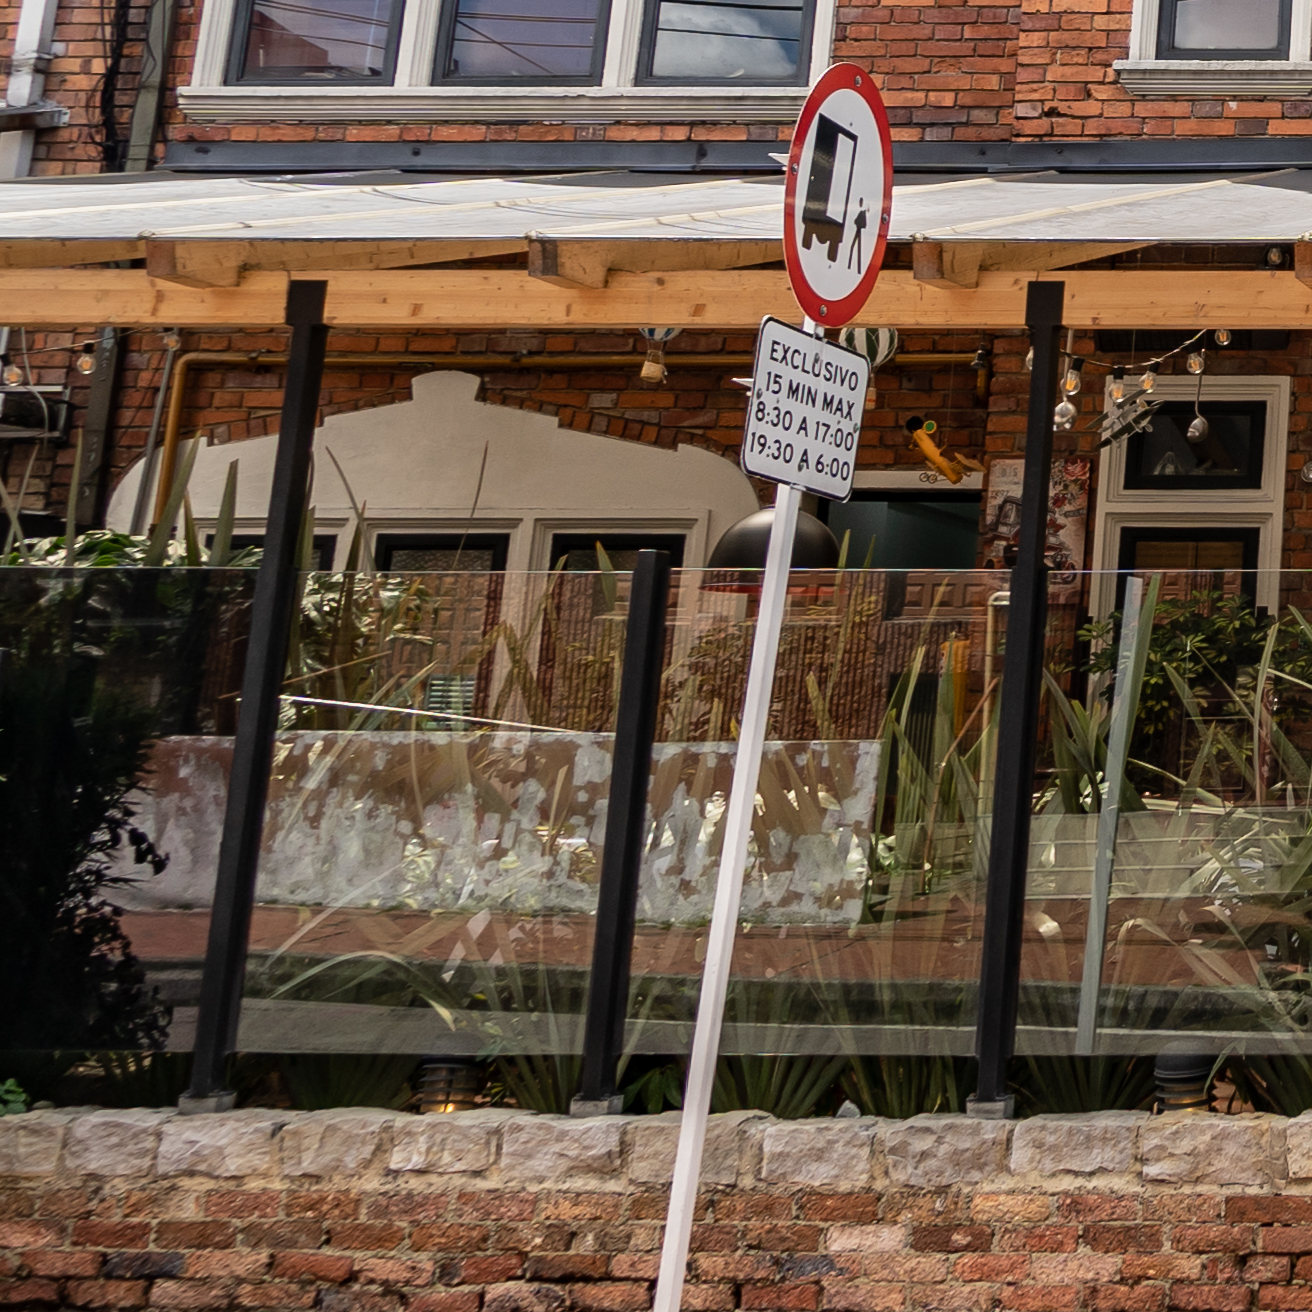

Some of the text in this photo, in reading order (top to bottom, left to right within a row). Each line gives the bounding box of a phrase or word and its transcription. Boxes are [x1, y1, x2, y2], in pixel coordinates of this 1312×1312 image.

[769, 339, 859, 392] EXCLUSIVO
[766, 371, 856, 422] 15 MIN MAX
[755, 400, 855, 452] 8:30 A 17:00
[749, 431, 851, 482] 19:30 A 6:00
